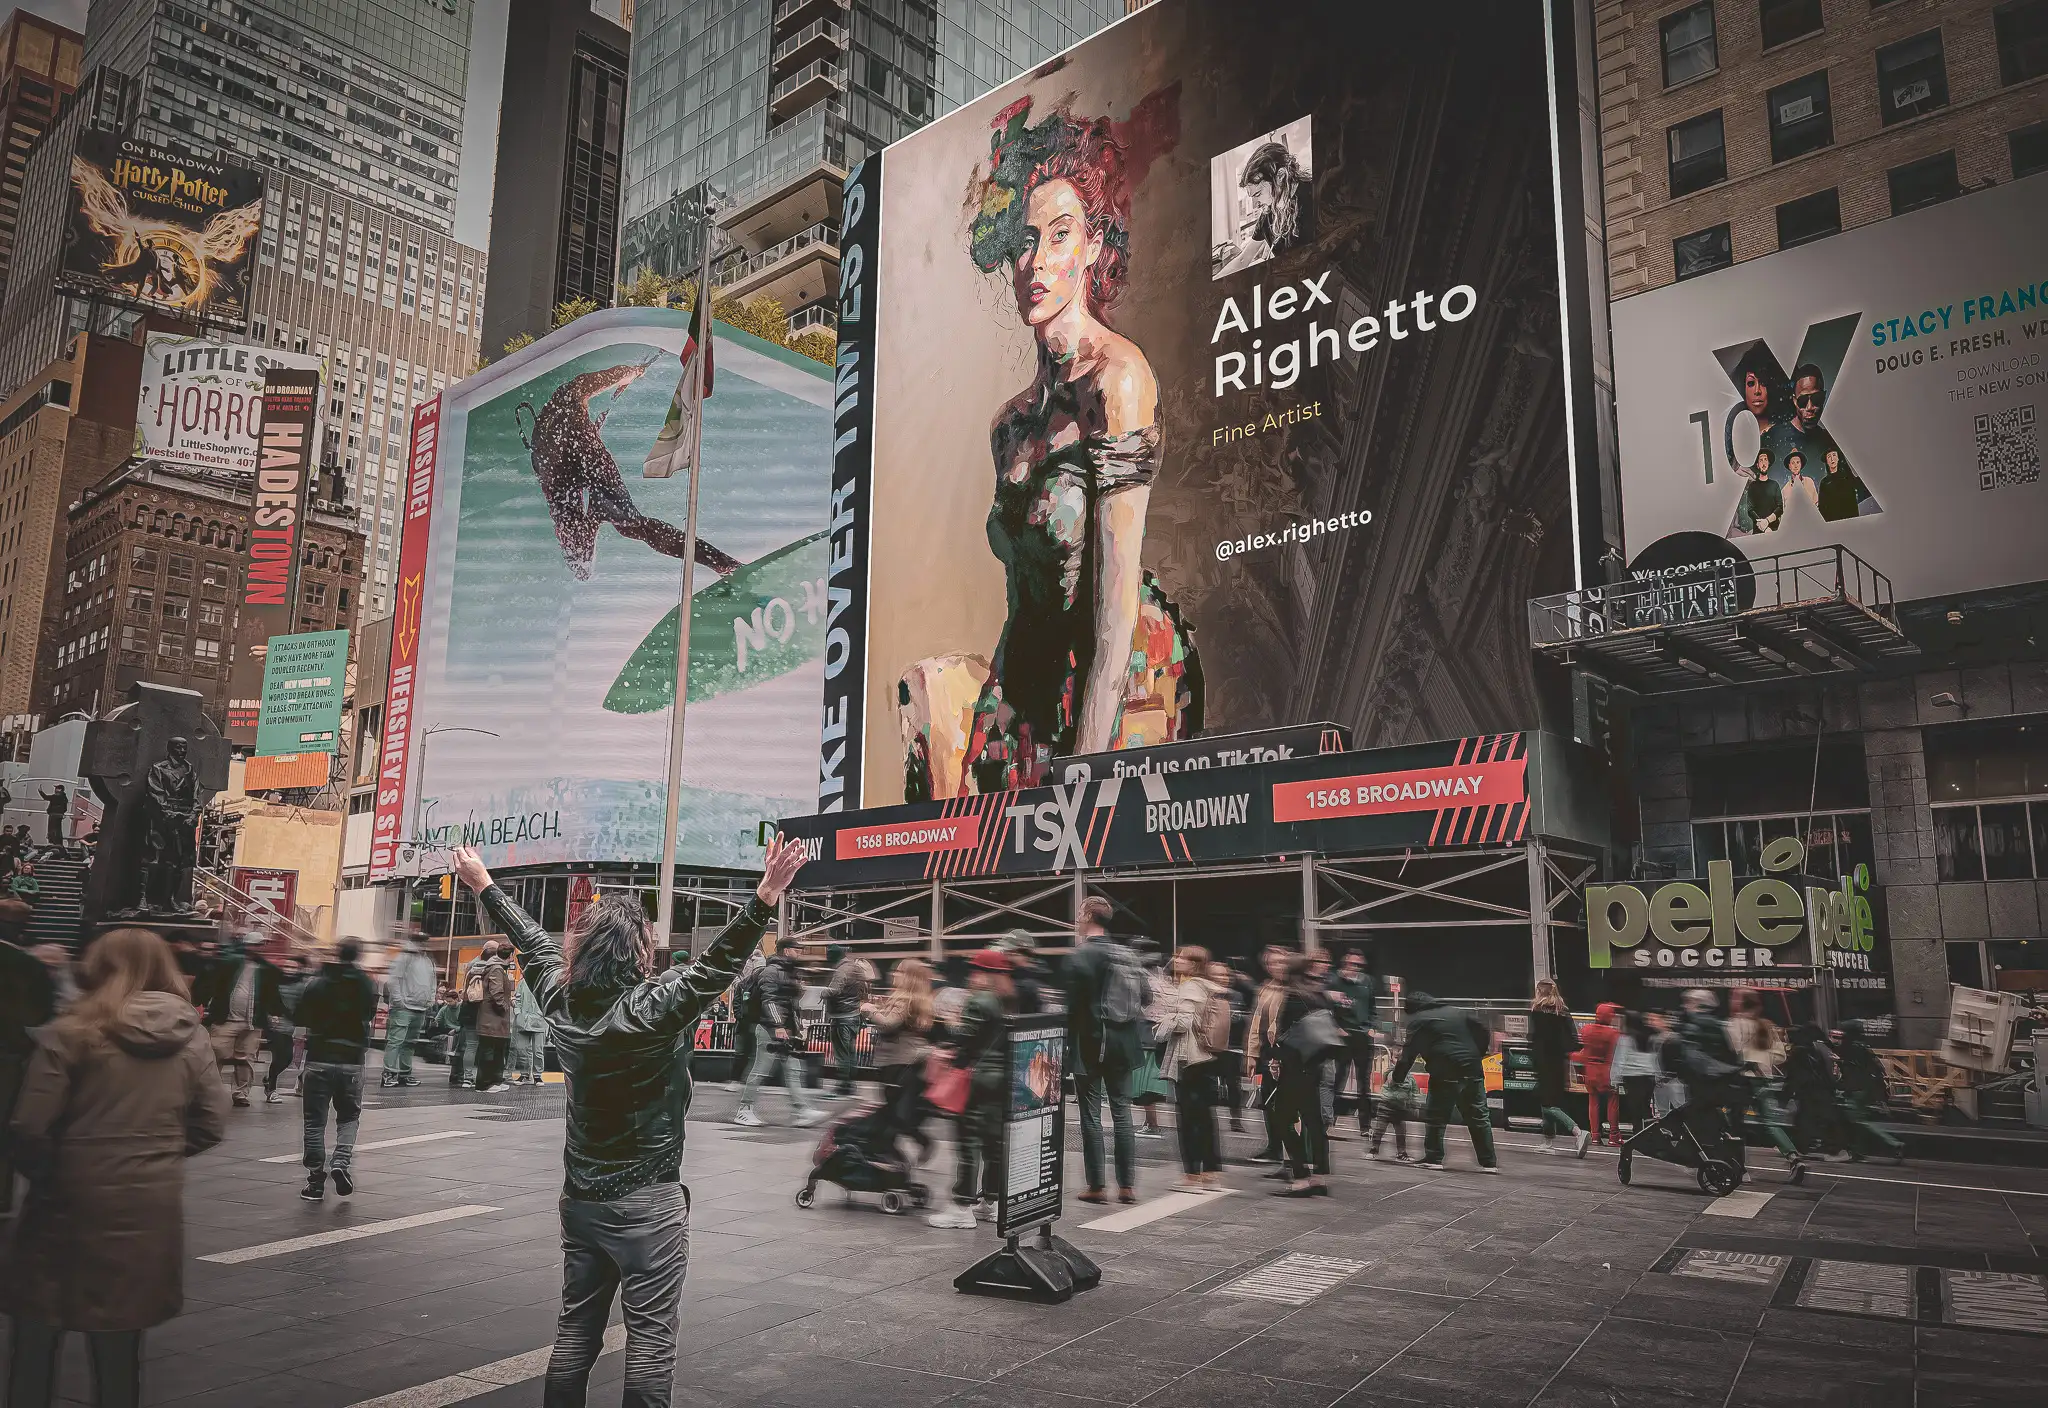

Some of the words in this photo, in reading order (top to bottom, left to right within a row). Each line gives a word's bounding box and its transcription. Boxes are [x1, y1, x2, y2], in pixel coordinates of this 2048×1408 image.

[121, 141, 144, 155] ON
[149, 148, 224, 175] BROADWAY
[110, 158, 169, 193] Harry
[170, 167, 229, 208] Potter
[132, 190, 170, 205] CURSED
[172, 200, 204, 214] CHILD
[1211, 270, 1333, 345] Alex
[1214, 284, 1478, 398] Righetto
[1871, 304, 1954, 347] STACY
[162, 346, 249, 377] LITTLE
[1875, 349, 1925, 375] DOUG
[1929, 345, 1945, 363] E.
[1950, 329, 2012, 358] FRESH,
[1956, 353, 2042, 382] DOWNLOAD
[225, 377, 243, 387] OF
[1947, 386, 1976, 402] THE
[1979, 378, 2012, 397] NEW
[2015, 369, 2048, 388] SON
[1213, 422, 1257, 447] Fine
[1262, 401, 1322, 433] Artist
[145, 446, 191, 460] Westside
[193, 452, 230, 465] Theatre
[236, 459, 255, 468] 407
[409, 421, 436, 520] INSIDE!
[244, 422, 304, 606] HADESTOWN
[1215, 509, 1373, 562] @alex.righetto
[1631, 560, 1709, 584] WELCOME
[1711, 557, 1736, 568] TO
[272, 654, 288, 664] JEWS
[288, 653, 303, 662] HAVE
[303, 651, 320, 661] MORE
[320, 649, 335, 659] THAN
[274, 642, 299, 652] ATTACKS
[298, 640, 307, 650] ON
[306, 638, 337, 649] ORTHODOX
[271, 665, 297, 675] DOUBLED
[268, 692, 288, 702] WORDS
[288, 692, 297, 700] DO
[297, 689, 316, 700] BREAK
[269, 681, 284, 691] DEAR
[240, 699, 262, 709] BROA
[267, 704, 287, 714] PLEASE
[287, 703, 302, 712] STOP
[302, 700, 333, 711] ATTACKING
[265, 716, 277, 726] OUR
[379, 663, 413, 806] HERSHEY'S
[1306, 788, 1351, 809] 1568
[1357, 775, 1484, 805] BROADWAY
[490, 810, 562, 845] BEACH.
[1005, 782, 1089, 871] TSX
[1145, 793, 1250, 833] BROADWAY
[855, 835, 883, 850] 1568
[885, 826, 958, 848] BROADWAY
[1585, 837, 1805, 969] pelé
[1805, 863, 1874, 966] pelé
[1633, 948, 1774, 968] SOCCER
[1829, 950, 1871, 972] SOCCER
[1723, 977, 1787, 988] GREATEST
[1841, 978, 1887, 989] STORE
[1699, 1250, 1782, 1267] STUDIO
